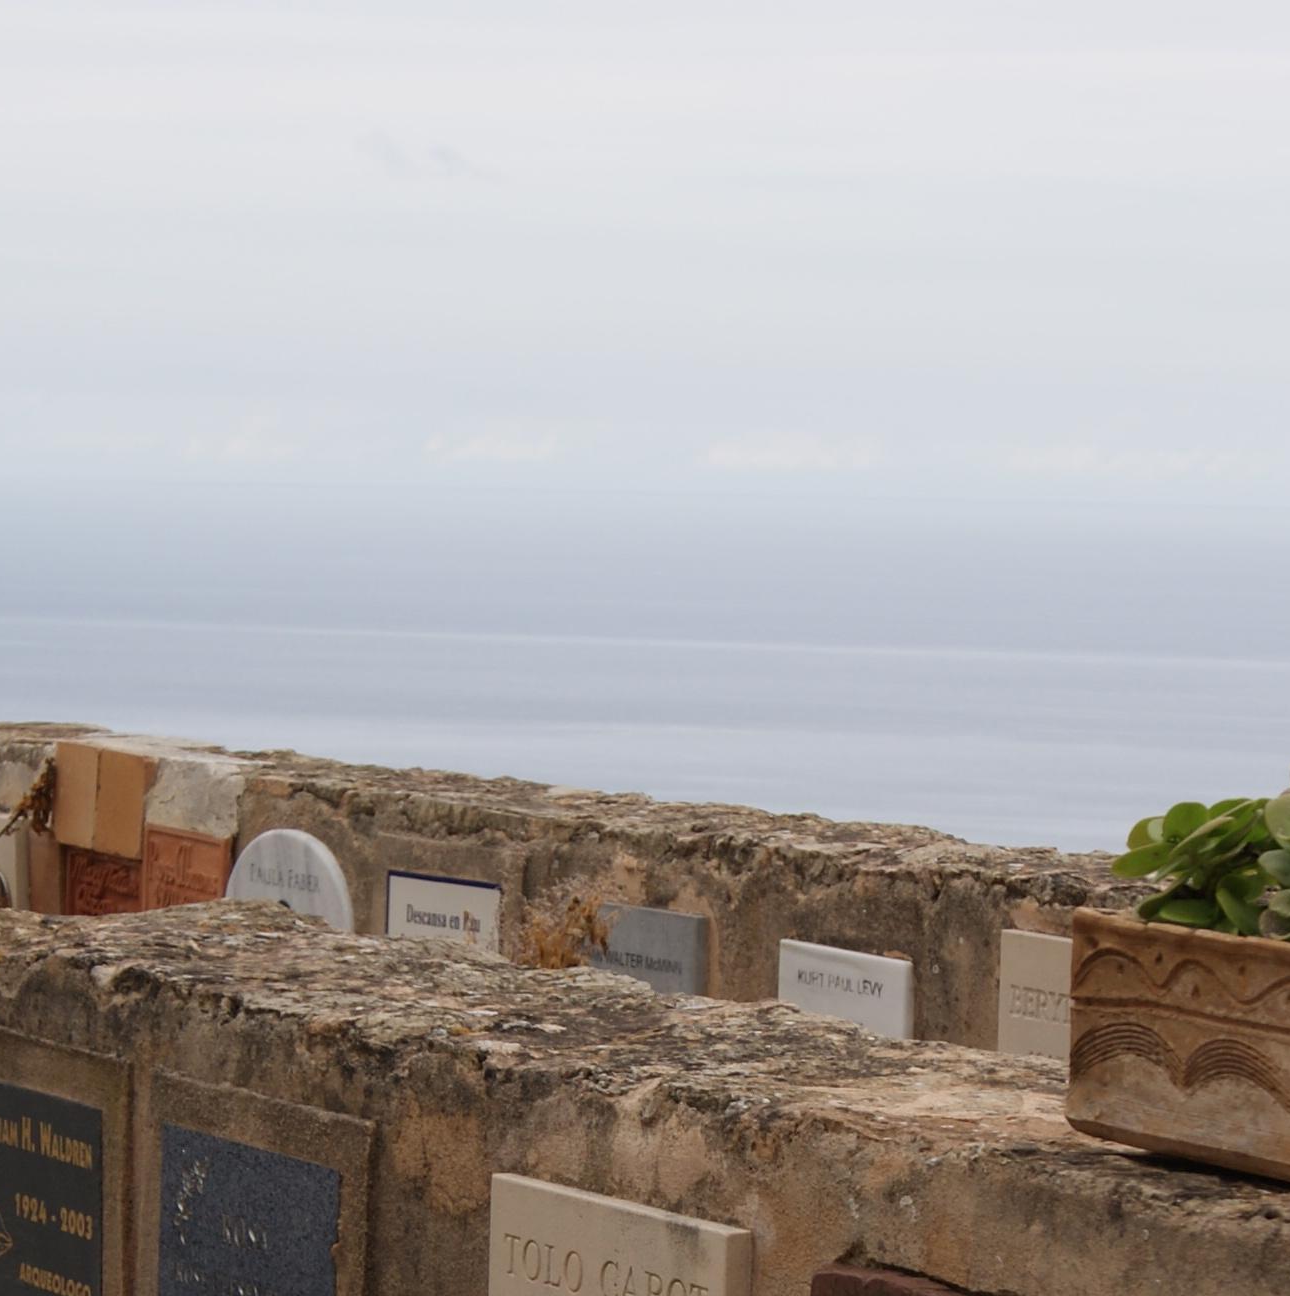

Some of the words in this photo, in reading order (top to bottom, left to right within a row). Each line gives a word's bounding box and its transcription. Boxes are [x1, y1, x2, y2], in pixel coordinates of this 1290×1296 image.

[406, 903, 446, 928] Descansa
[450, 915, 460, 930] en
[607, 950, 643, 969] WALTER
[797, 968, 824, 989] KURT
[827, 974, 854, 994] PAUL
[857, 978, 884, 999] LEVY
[21, 1115, 35, 1153] H.
[39, 1120, 93, 1171] WALDREN
[14, 1192, 47, 1225] 1924
[59, 1206, 93, 1241] 2003
[504, 1233, 584, 1293] TOLO
